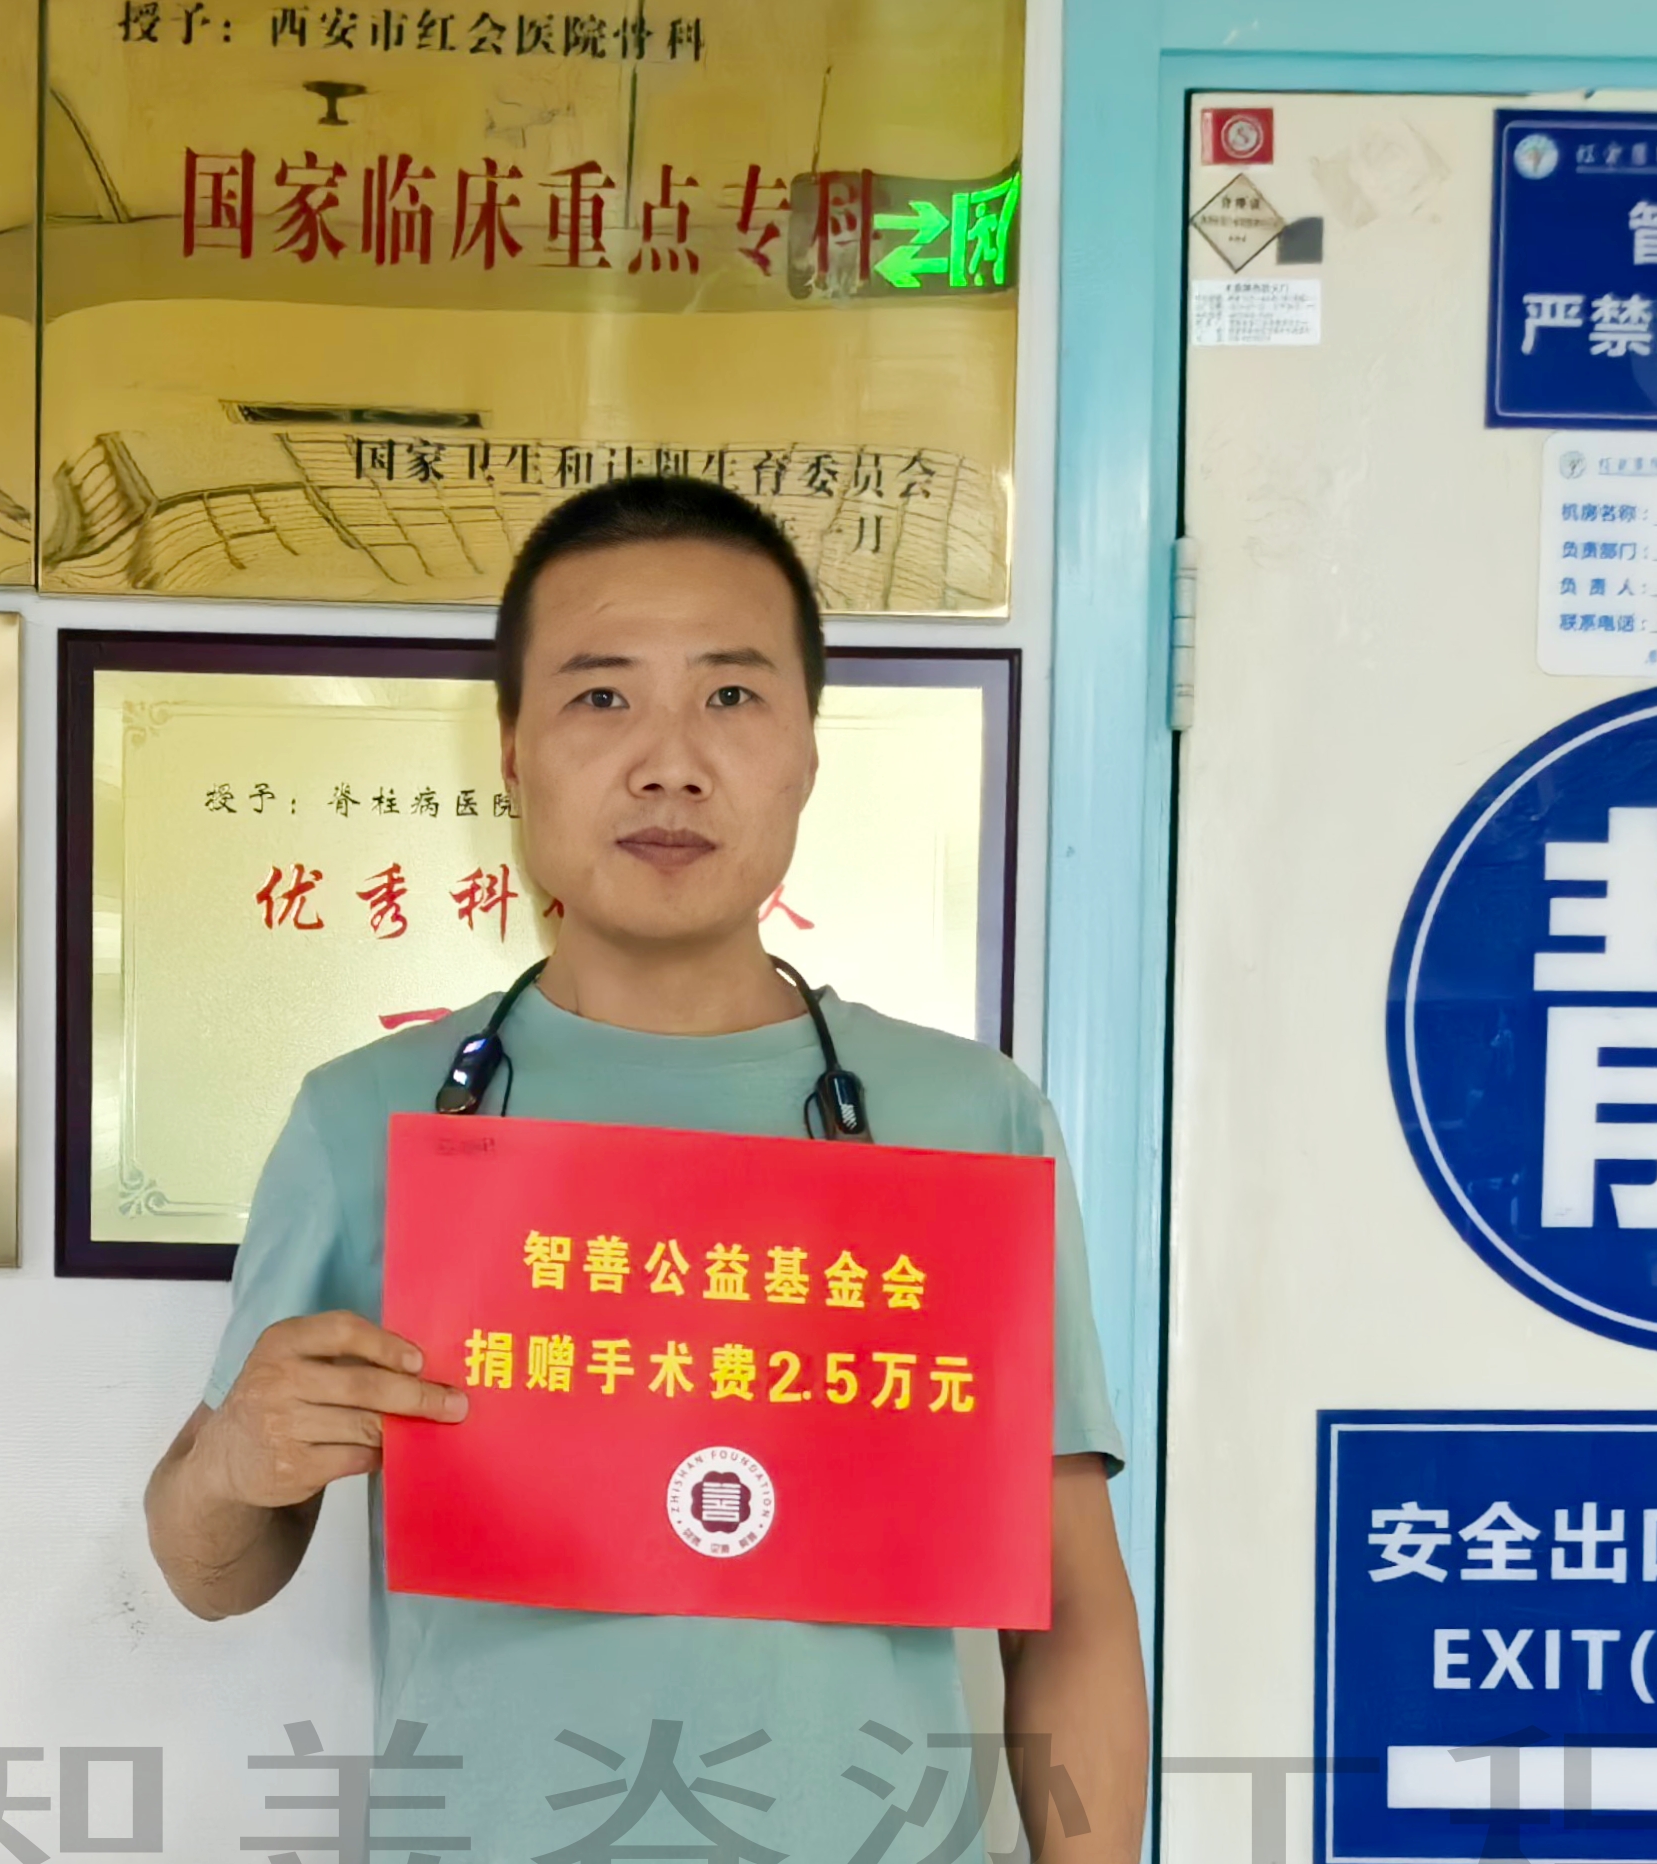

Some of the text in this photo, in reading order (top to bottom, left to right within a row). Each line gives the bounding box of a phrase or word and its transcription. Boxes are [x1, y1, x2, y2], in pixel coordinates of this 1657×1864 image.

[182, 146, 882, 282] 国家临床重点专科
[523, 1230, 927, 1311] 智善公益基金会
[465, 1328, 976, 1414] 捐赠手术费2.5万元
